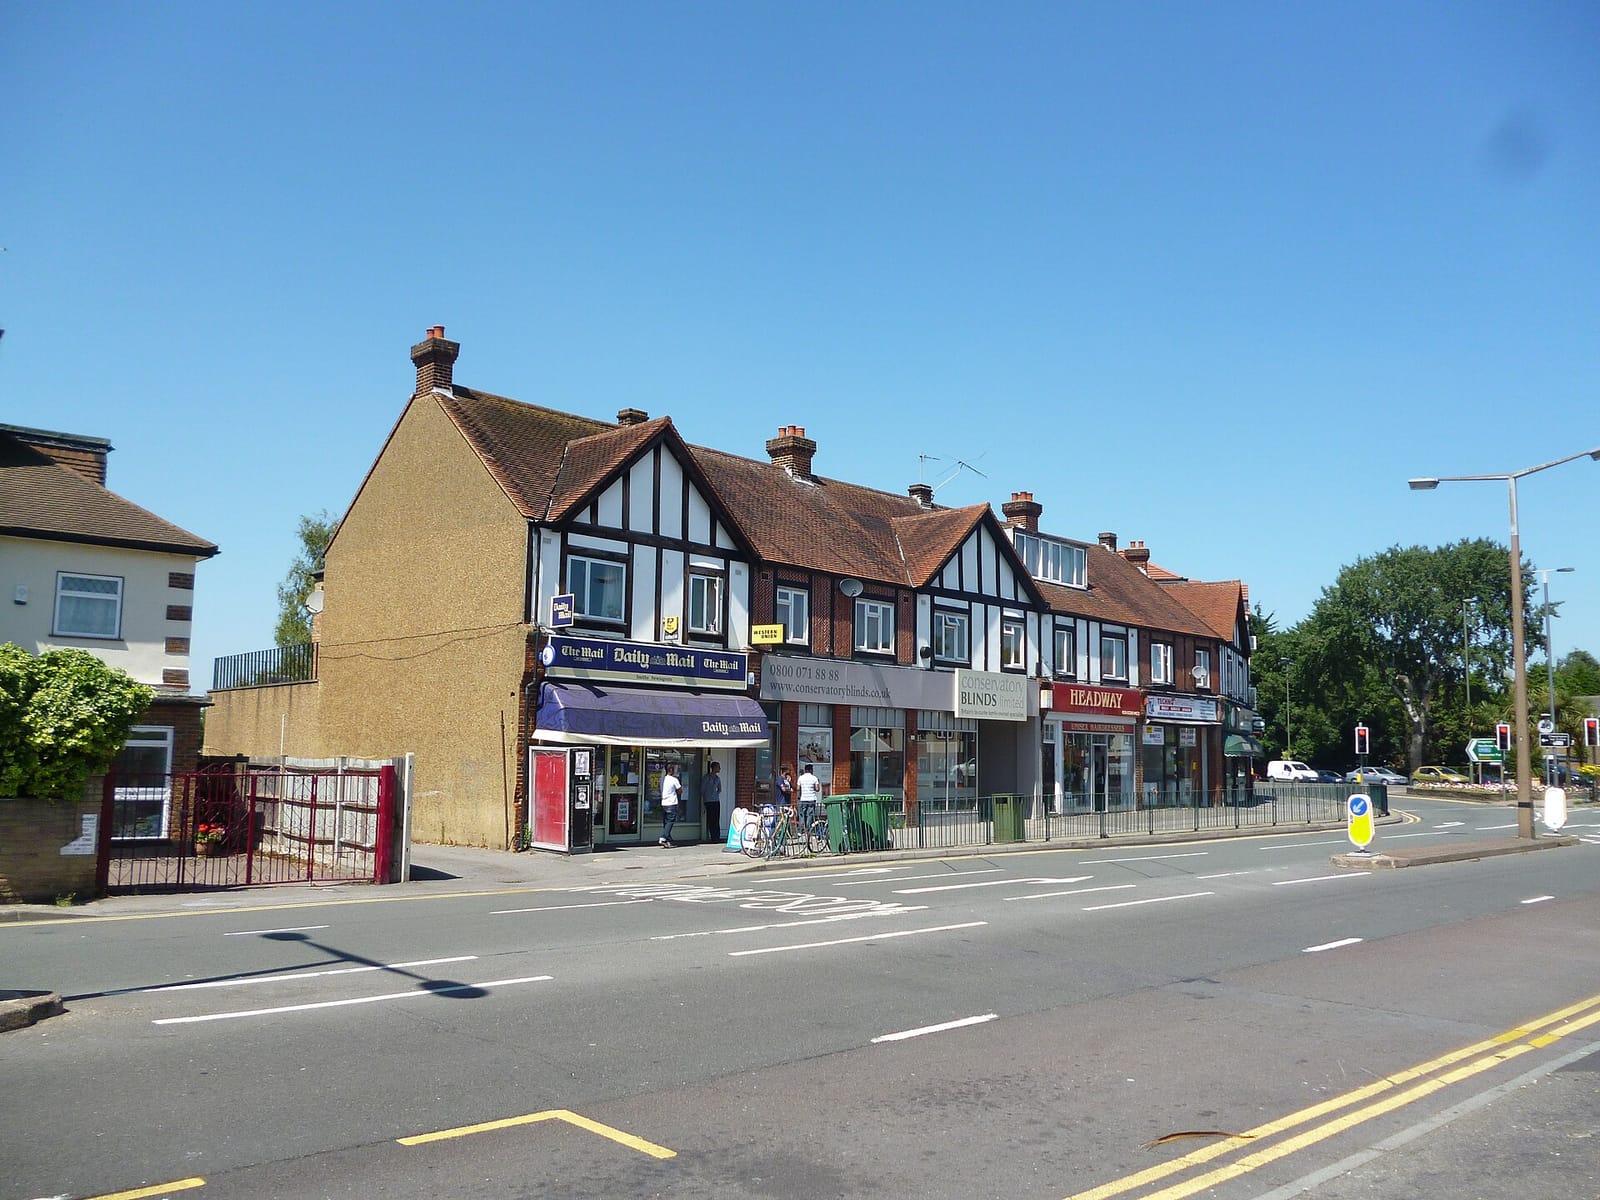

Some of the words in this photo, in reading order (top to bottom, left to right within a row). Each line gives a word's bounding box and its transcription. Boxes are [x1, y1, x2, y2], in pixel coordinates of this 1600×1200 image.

[553, 603, 569, 611] Daily
[561, 645, 580, 656] The
[581, 647, 604, 659] Mail
[613, 647, 650, 669] Daily
[666, 653, 695, 668] Mail
[703, 658, 720, 669] The
[720, 660, 739, 670] Mail
[769, 663, 793, 678] 0800
[796, 666, 812, 679] 071
[815, 668, 826, 680] 88
[828, 669, 839, 681] 88
[769, 681, 891, 699] www.conservatoryblinds.co.uk
[961, 676, 1024, 693] conservatory
[961, 691, 997, 706] BLINDS
[999, 696, 1024, 709] limited
[1070, 688, 1123, 709] HEADWAY
[702, 720, 729, 736] Daily
[738, 722, 761, 733] Mail
